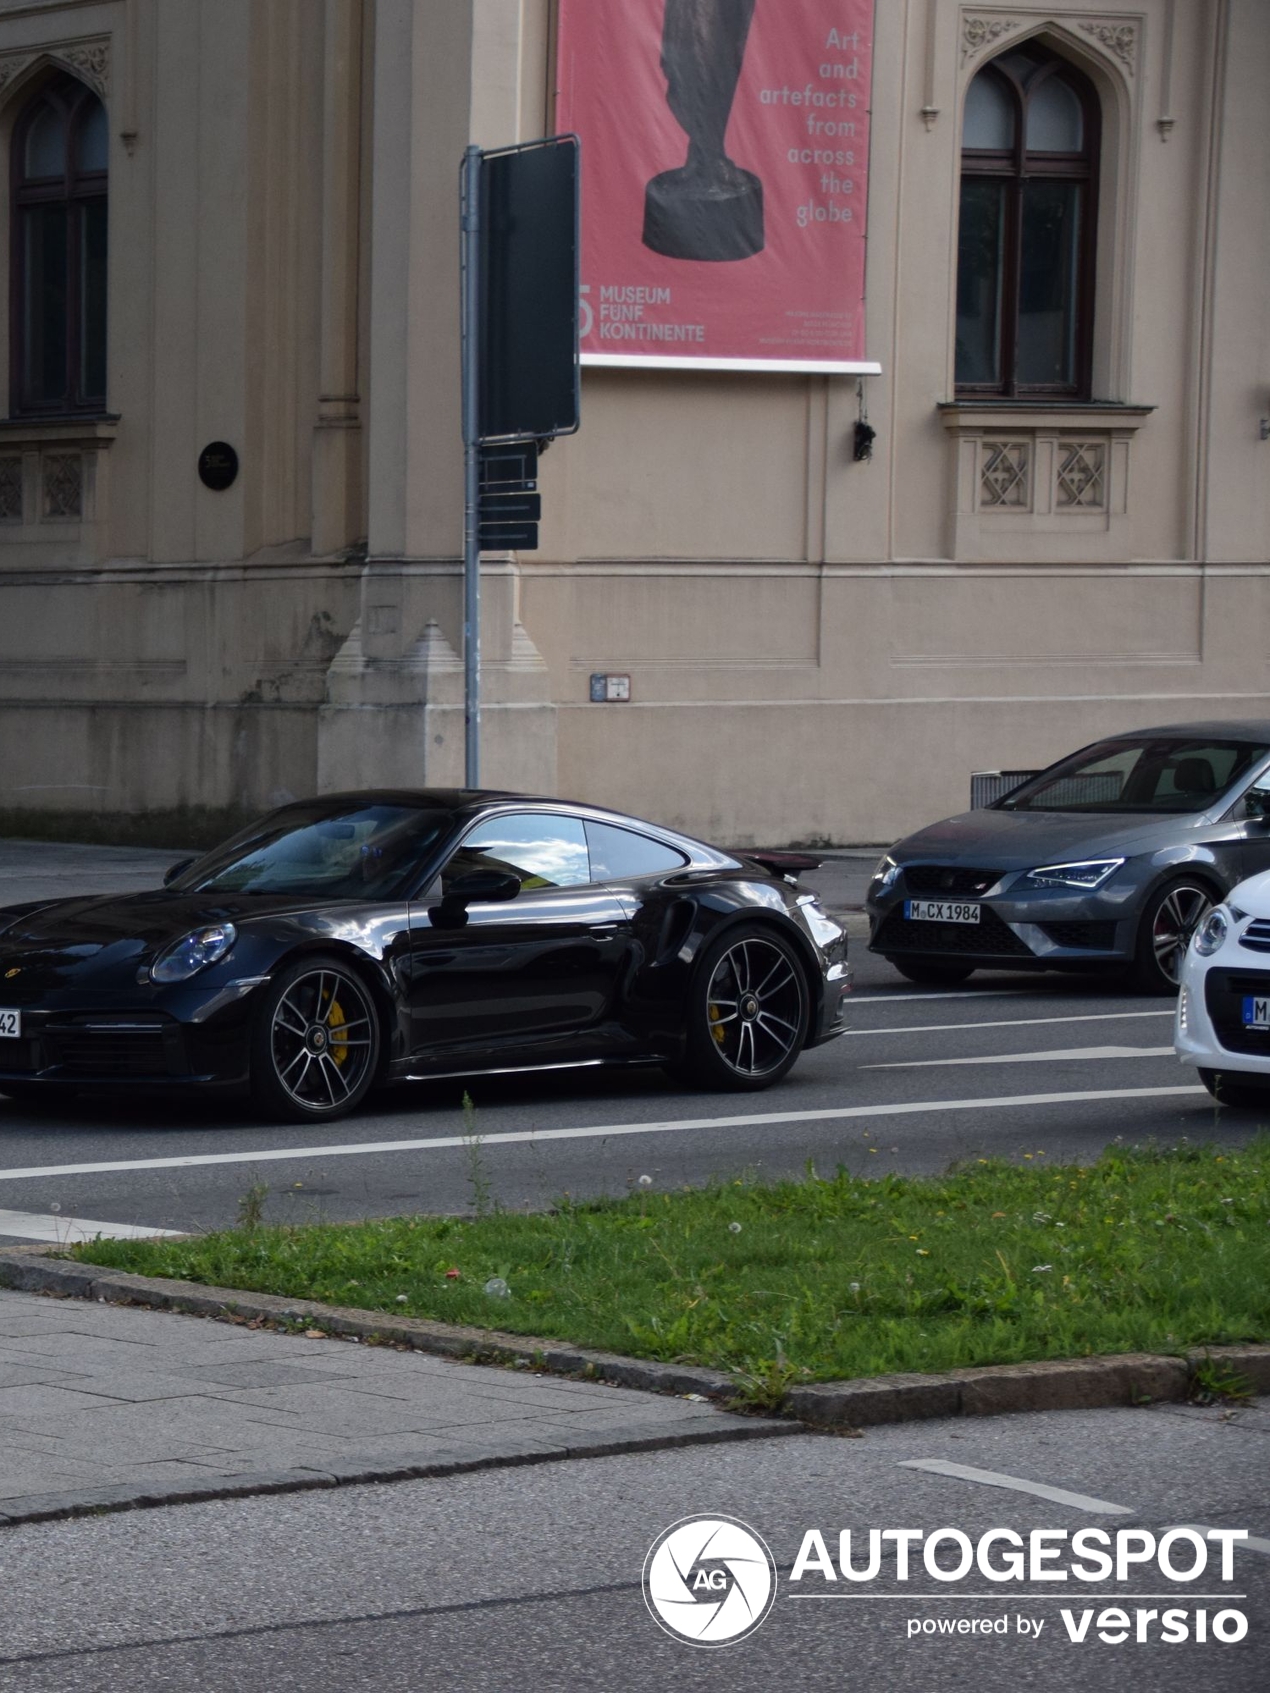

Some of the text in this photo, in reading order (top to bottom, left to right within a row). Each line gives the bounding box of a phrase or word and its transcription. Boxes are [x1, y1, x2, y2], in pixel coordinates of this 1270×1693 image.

[825, 27, 859, 50] Art
[819, 58, 858, 79] and
[759, 84, 857, 108] artefacts
[806, 114, 856, 138] from
[787, 146, 855, 166] across
[820, 172, 854, 194] the
[796, 200, 853, 228] globe
[599, 285, 671, 305] MUSEUM
[599, 303, 644, 322] FÜNF
[599, 322, 705, 343] KONTINENTE
[911, 903, 920, 918] M
[927, 904, 943, 919] CX
[946, 905, 978, 921] 1984
[1255, 1000, 1266, 1021] M
